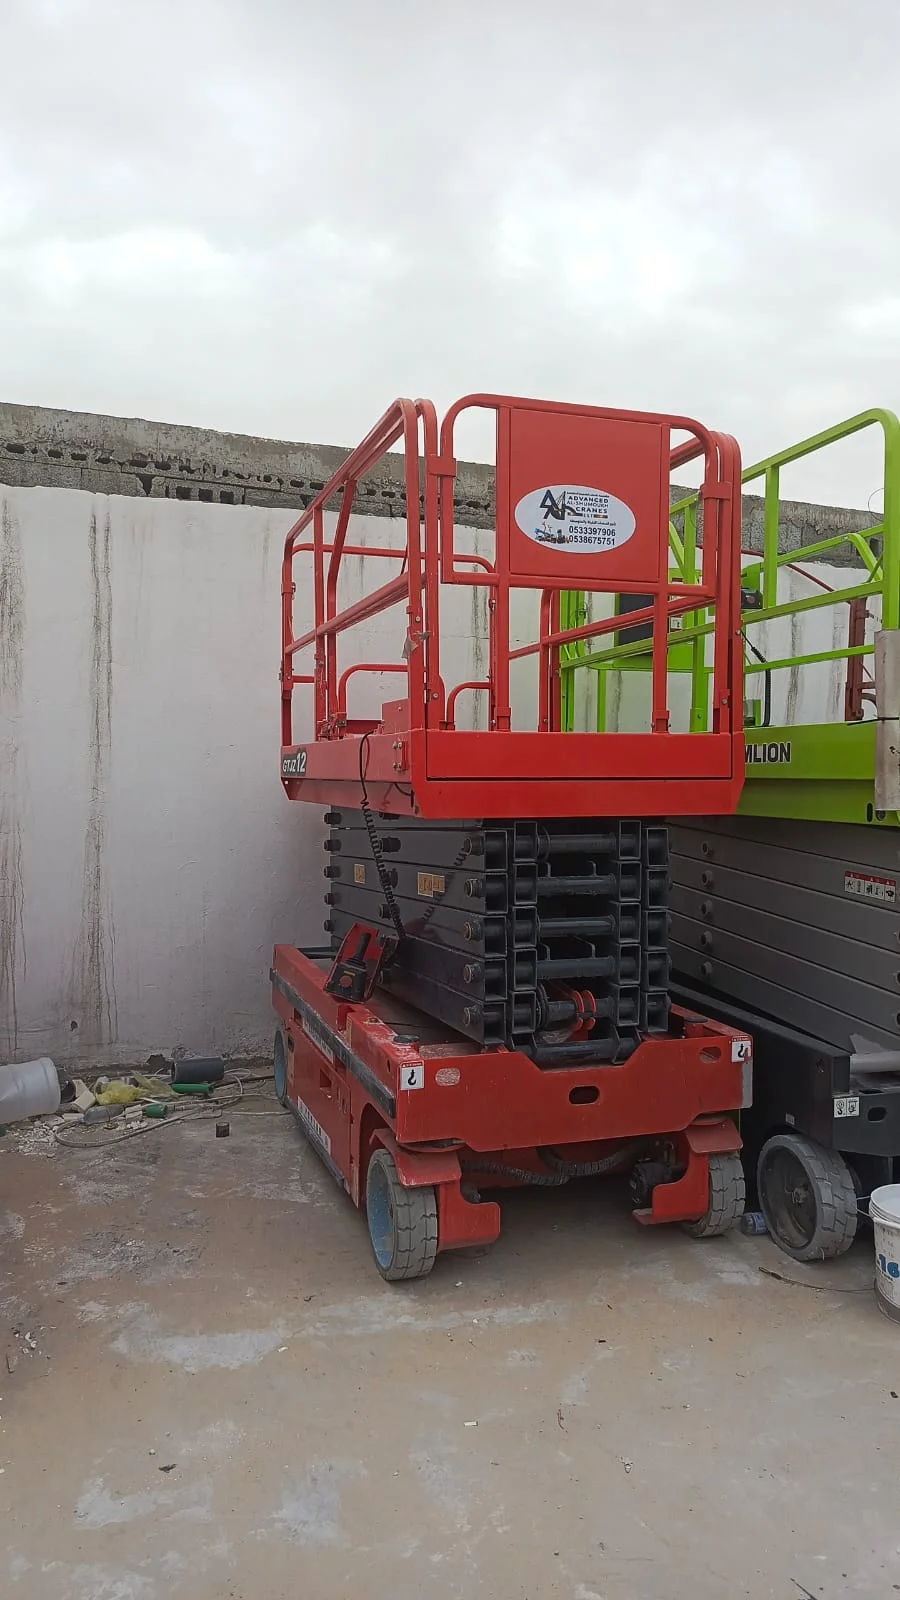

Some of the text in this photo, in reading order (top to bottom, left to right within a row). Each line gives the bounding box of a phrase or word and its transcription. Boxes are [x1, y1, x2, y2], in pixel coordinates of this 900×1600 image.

[568, 496, 609, 504] ADVANCED
[568, 525, 616, 537] 0533397906
[568, 534, 615, 546] 0538675751
